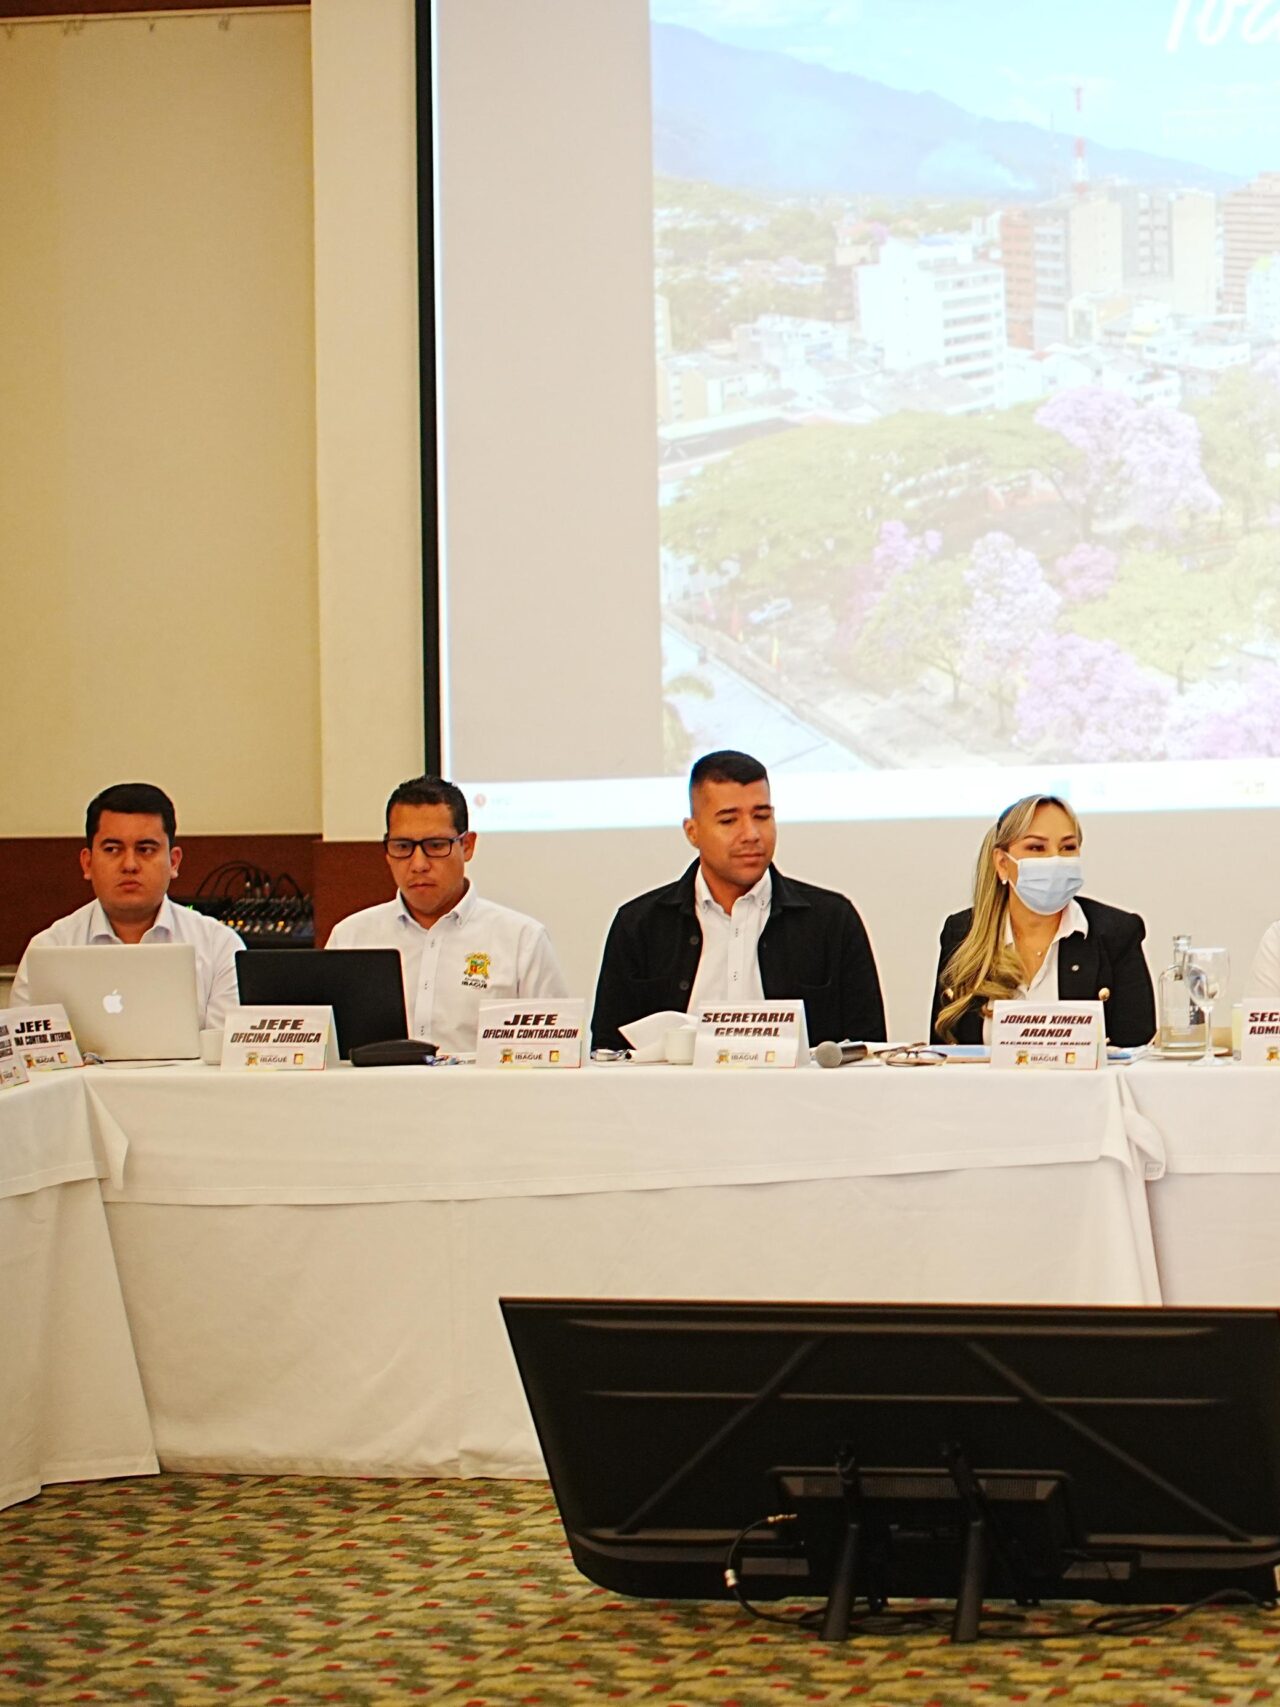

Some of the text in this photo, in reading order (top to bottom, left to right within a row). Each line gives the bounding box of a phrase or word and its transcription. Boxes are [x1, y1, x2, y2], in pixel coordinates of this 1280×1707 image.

[503, 1014, 558, 1026] JEFE
[701, 1012, 795, 1023] SECRETARIA
[1000, 1015, 1093, 1025] JOHANA XIMENA
[15, 1019, 52, 1034] JEFE
[250, 1019, 305, 1030] JEFE
[482, 1029, 579, 1039] OFICINA CONTRATACION
[714, 1027, 780, 1037] GENERAL
[1019, 1028, 1073, 1038] ARANDA
[230, 1033, 322, 1043] OFICINA JURIDICA
